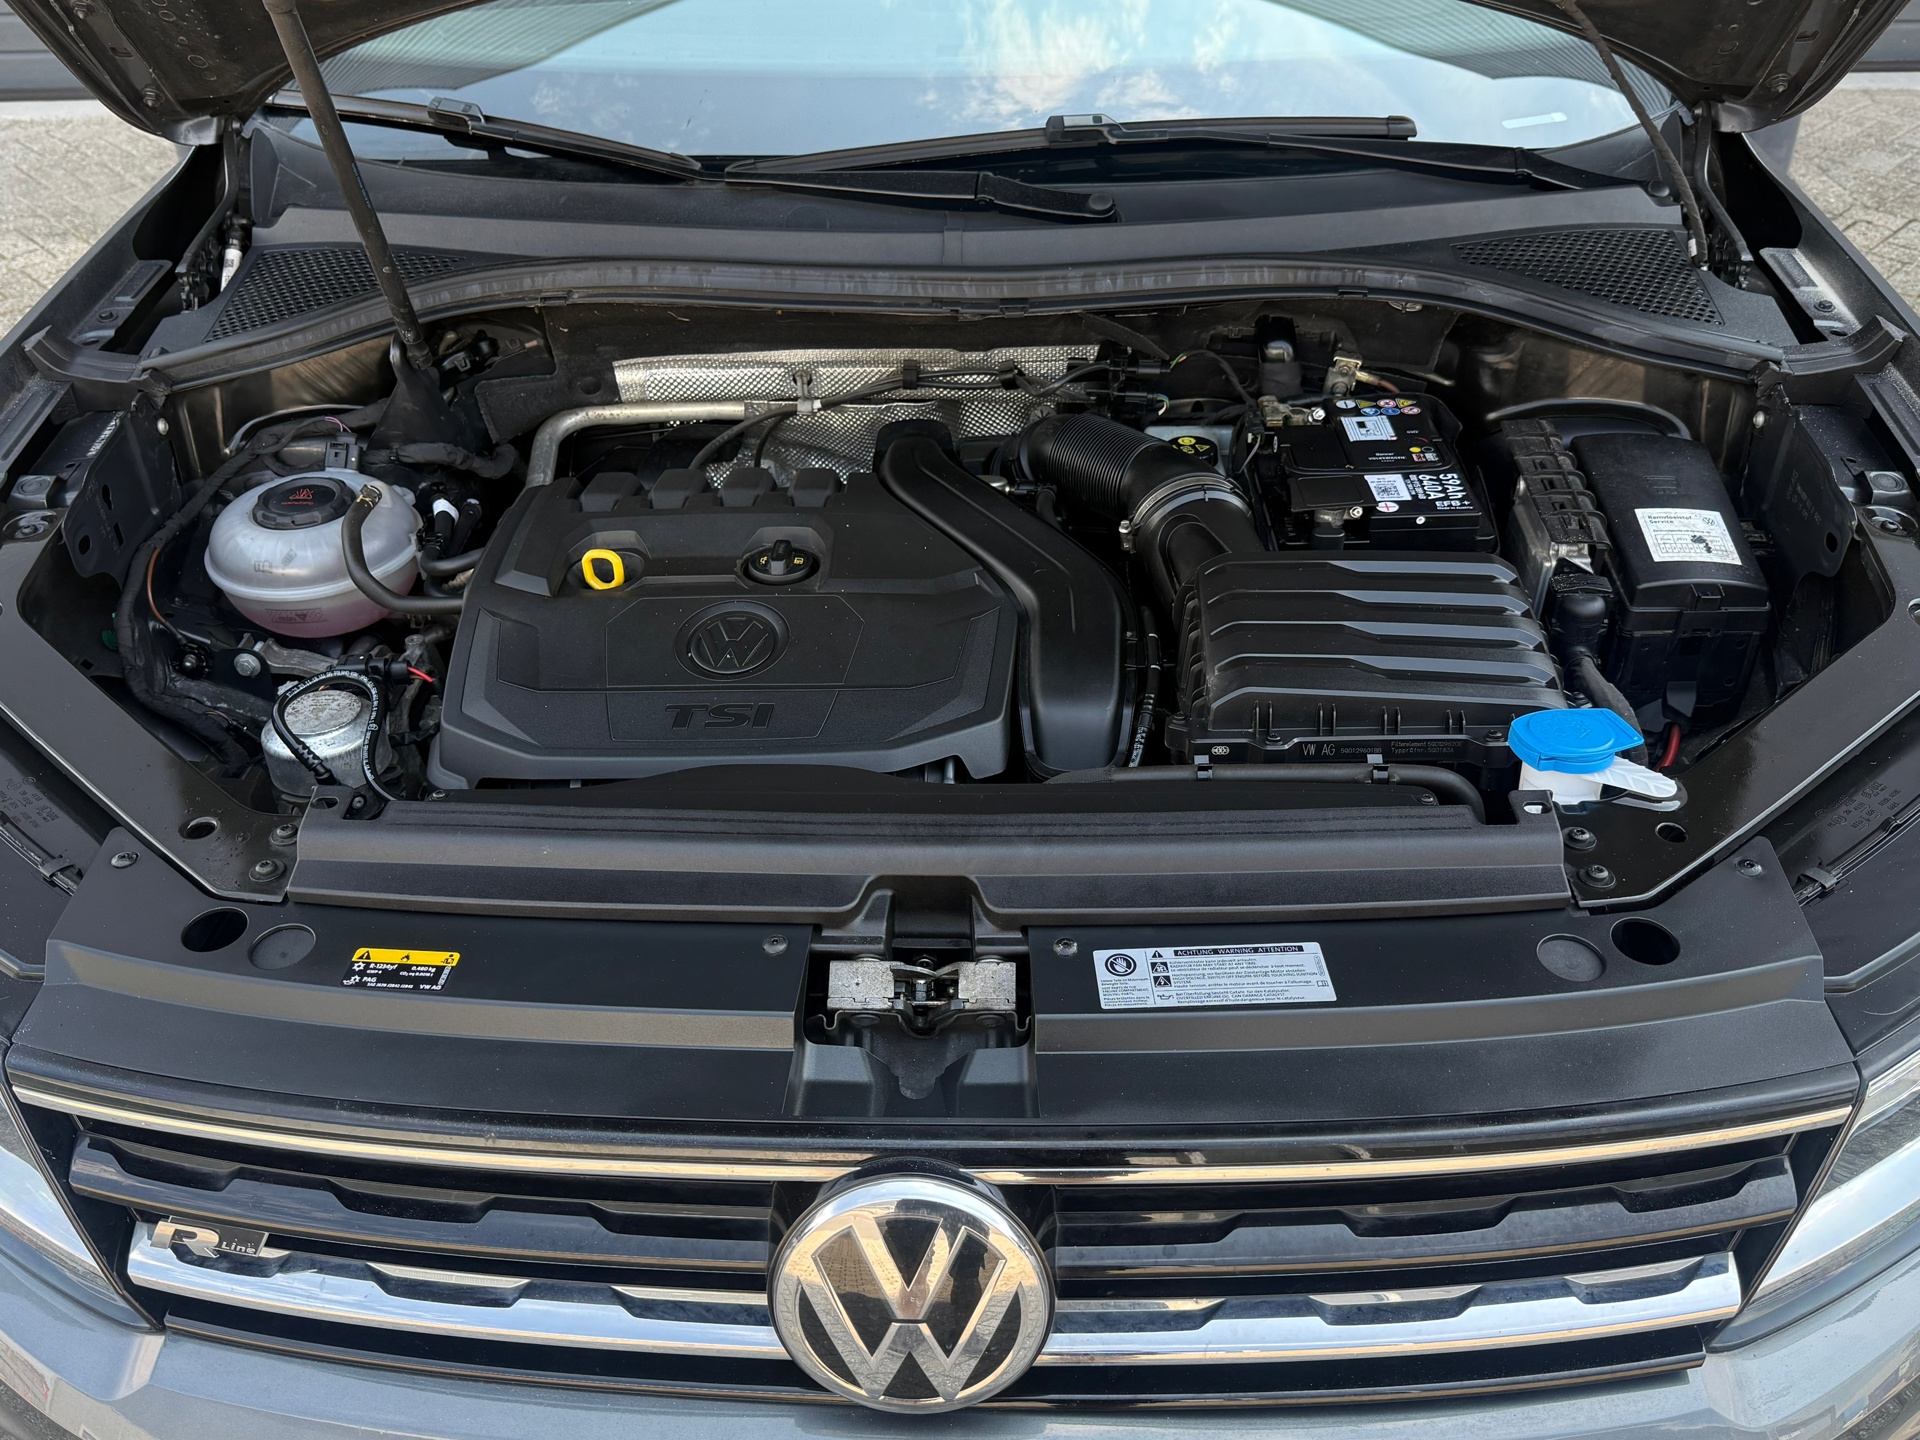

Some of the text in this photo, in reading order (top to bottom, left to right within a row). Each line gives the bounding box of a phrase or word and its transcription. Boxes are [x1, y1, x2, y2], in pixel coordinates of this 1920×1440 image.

[1419, 474, 1446, 500] 640A
[1439, 473, 1467, 499] 59Ah
[665, 703, 776, 730] TSI
[1302, 743, 1316, 756] VW
[1321, 743, 1336, 756] AG
[150, 1220, 256, 1258] R Line
[792, 1205, 1028, 1402] VW
